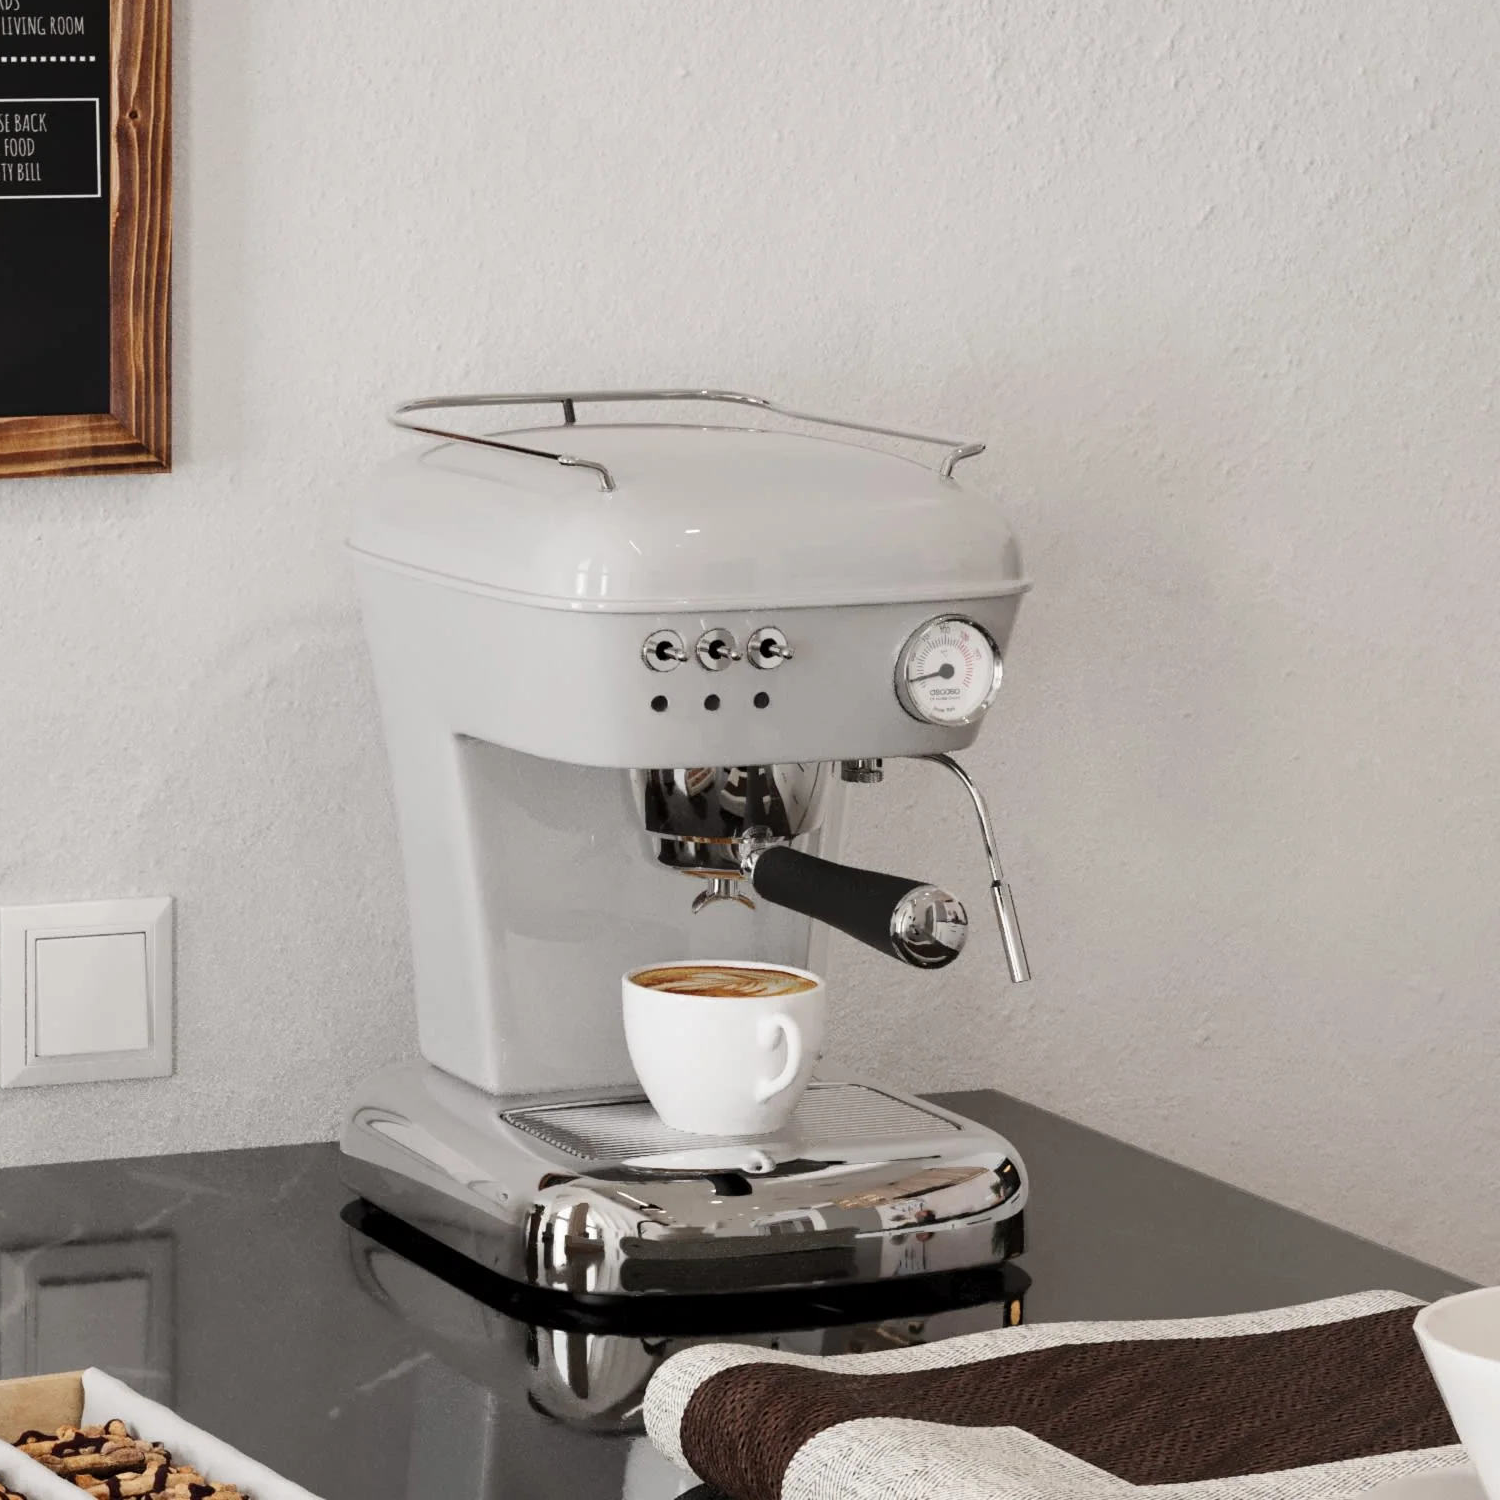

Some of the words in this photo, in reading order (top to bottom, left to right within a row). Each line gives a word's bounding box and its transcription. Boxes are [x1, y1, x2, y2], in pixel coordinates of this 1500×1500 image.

[1, 16, 47, 36] LIVING
[49, 15, 85, 36] ROOM
[14, 112, 48, 133] BACK
[4, 137, 35, 157] FOOD
[17, 162, 42, 182] BILL
